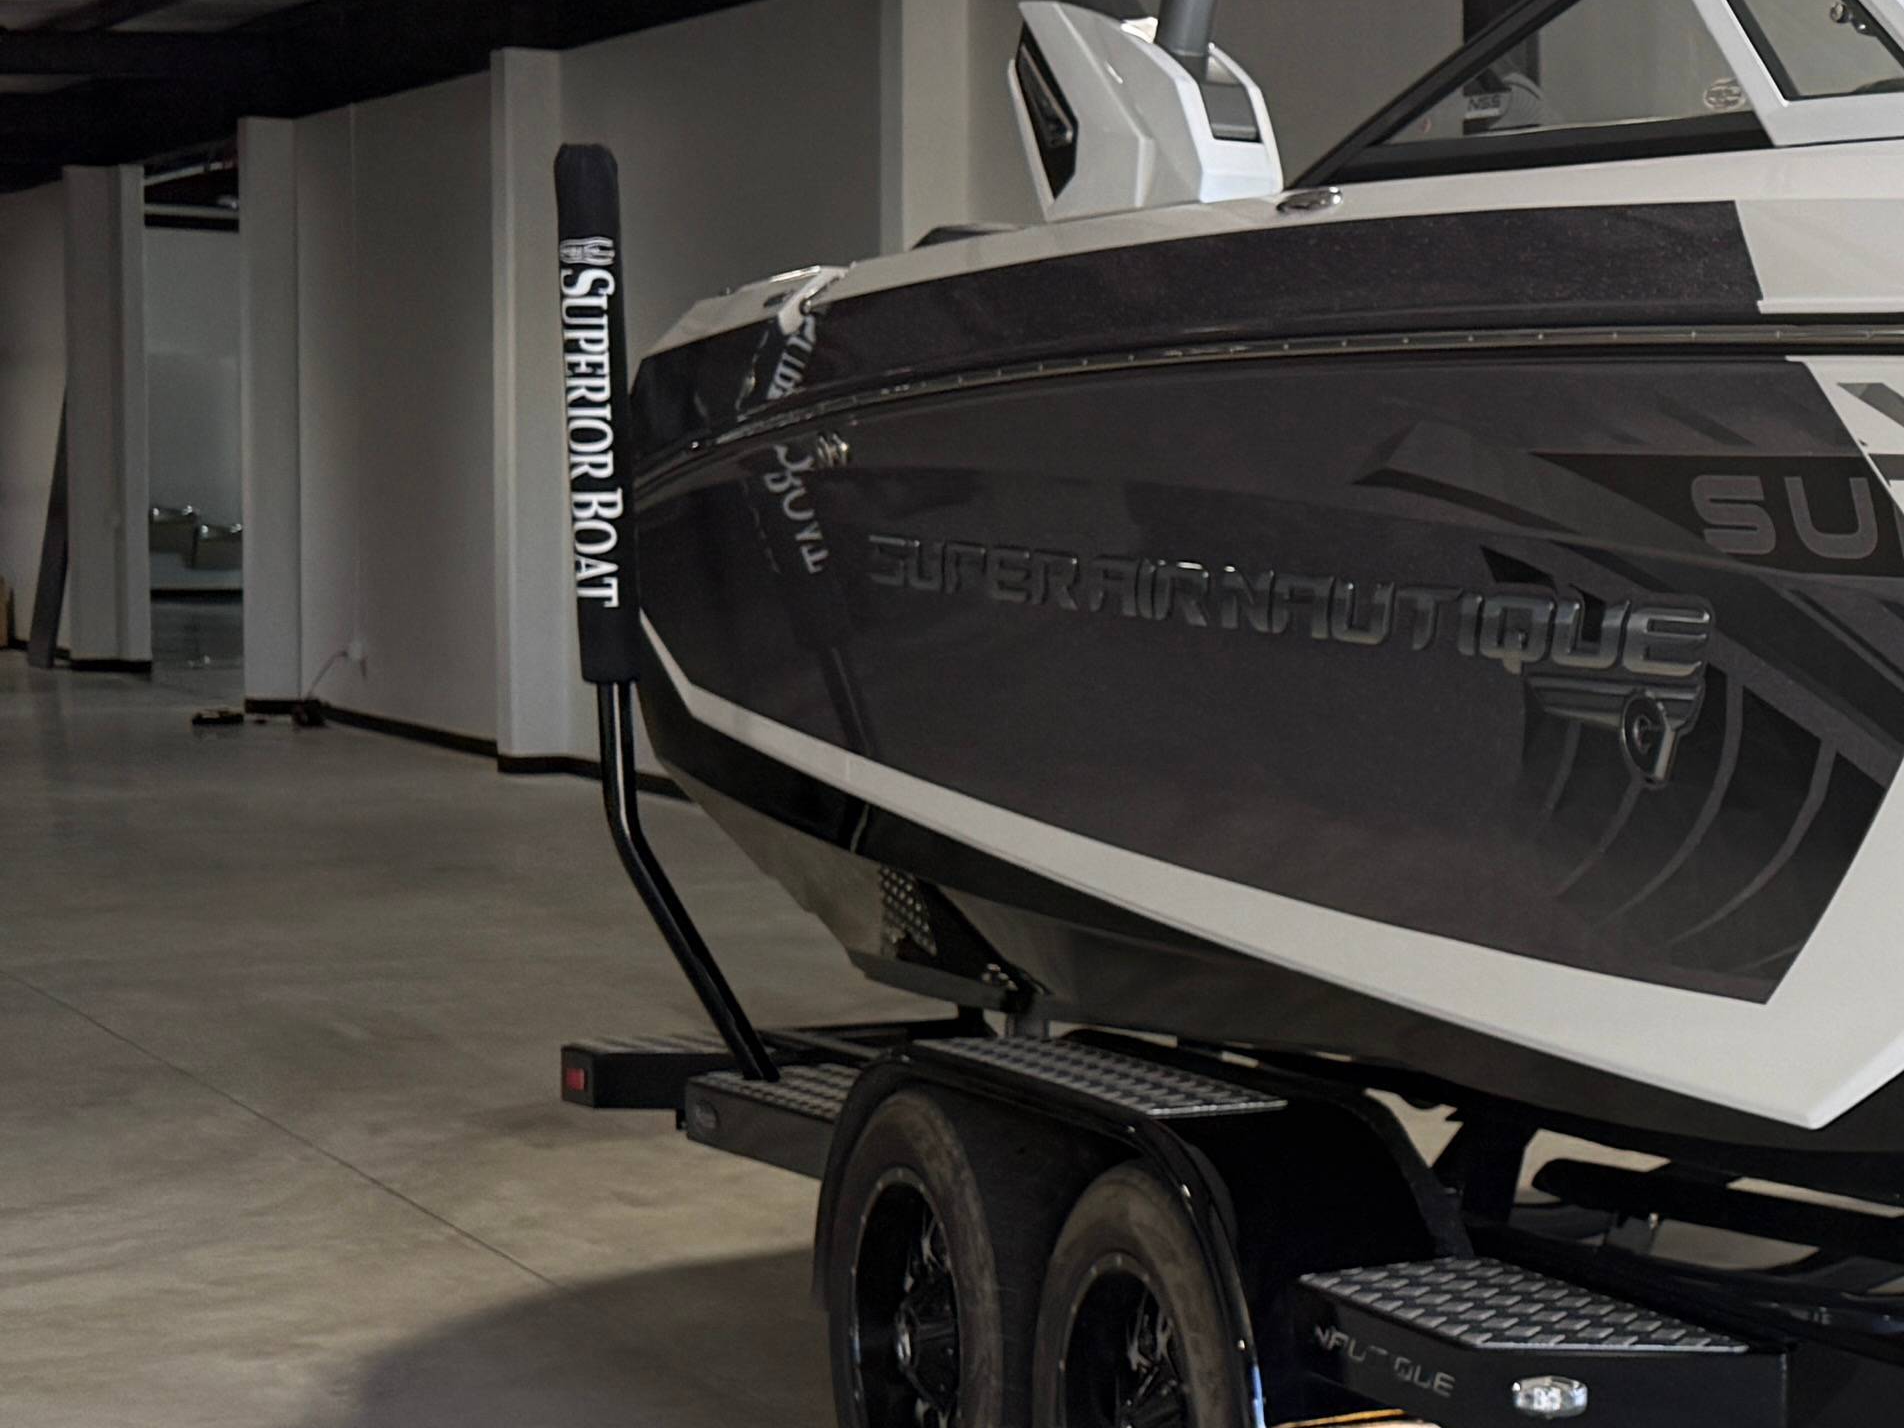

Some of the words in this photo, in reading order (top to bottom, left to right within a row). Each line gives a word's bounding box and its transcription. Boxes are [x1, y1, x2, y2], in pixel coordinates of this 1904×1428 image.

[559, 268, 616, 476] SUPERIOR
[570, 486, 624, 609] BOAT
[1314, 1325, 1457, 1399] NAUTQUE
